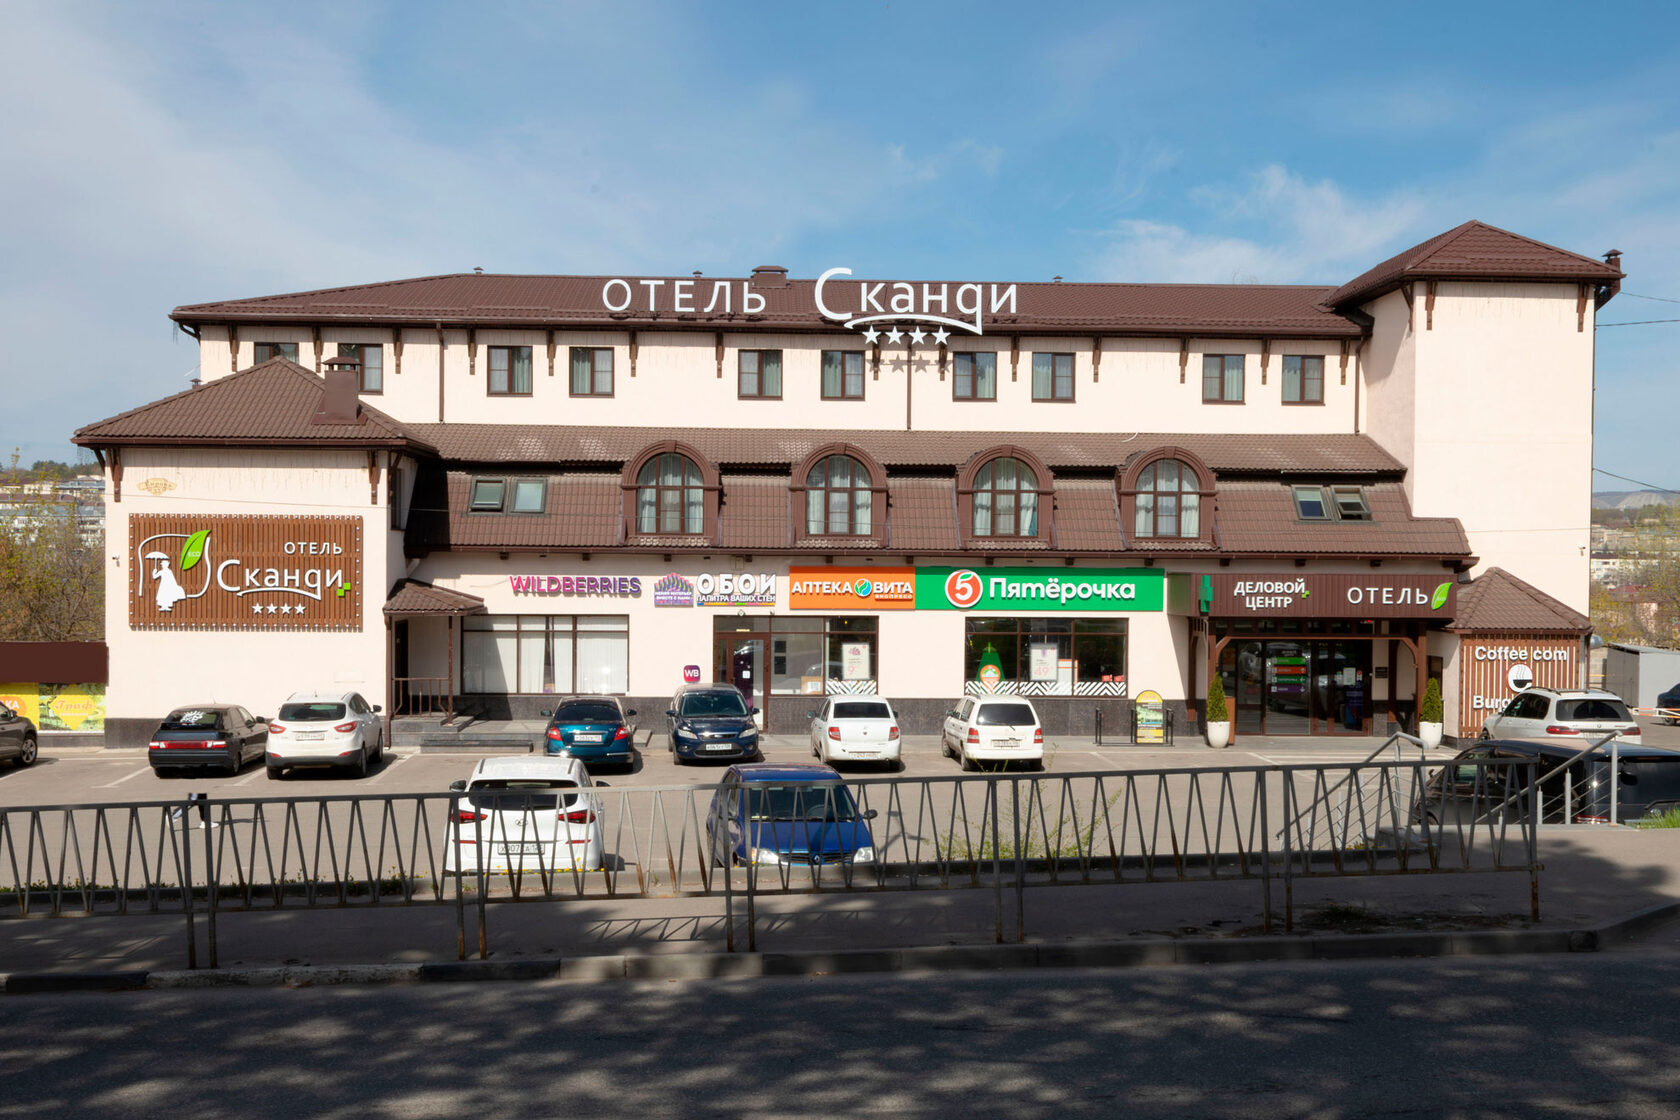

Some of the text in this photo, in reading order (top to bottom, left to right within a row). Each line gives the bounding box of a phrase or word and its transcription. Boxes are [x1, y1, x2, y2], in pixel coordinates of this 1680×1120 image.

[602, 267, 1017, 335] ОТЕЛЬ Сканди
[284, 541, 343, 554] ОТЕЛЬ
[216, 559, 343, 601] Сканди
[509, 575, 642, 594] WILDBERRIES
[696, 573, 777, 595] ОБОИ
[791, 581, 913, 594] АПТЕКА ВИТА
[955, 573, 1136, 603] 5 Пятёрочка
[1234, 578, 1306, 596] ДЕЛОВОЙ
[1246, 596, 1293, 611] ЦЕНТР
[1347, 587, 1429, 605] ОТЕЛЬ
[1474, 646, 1568, 661] Coffee com
[684, 669, 700, 678] WB
